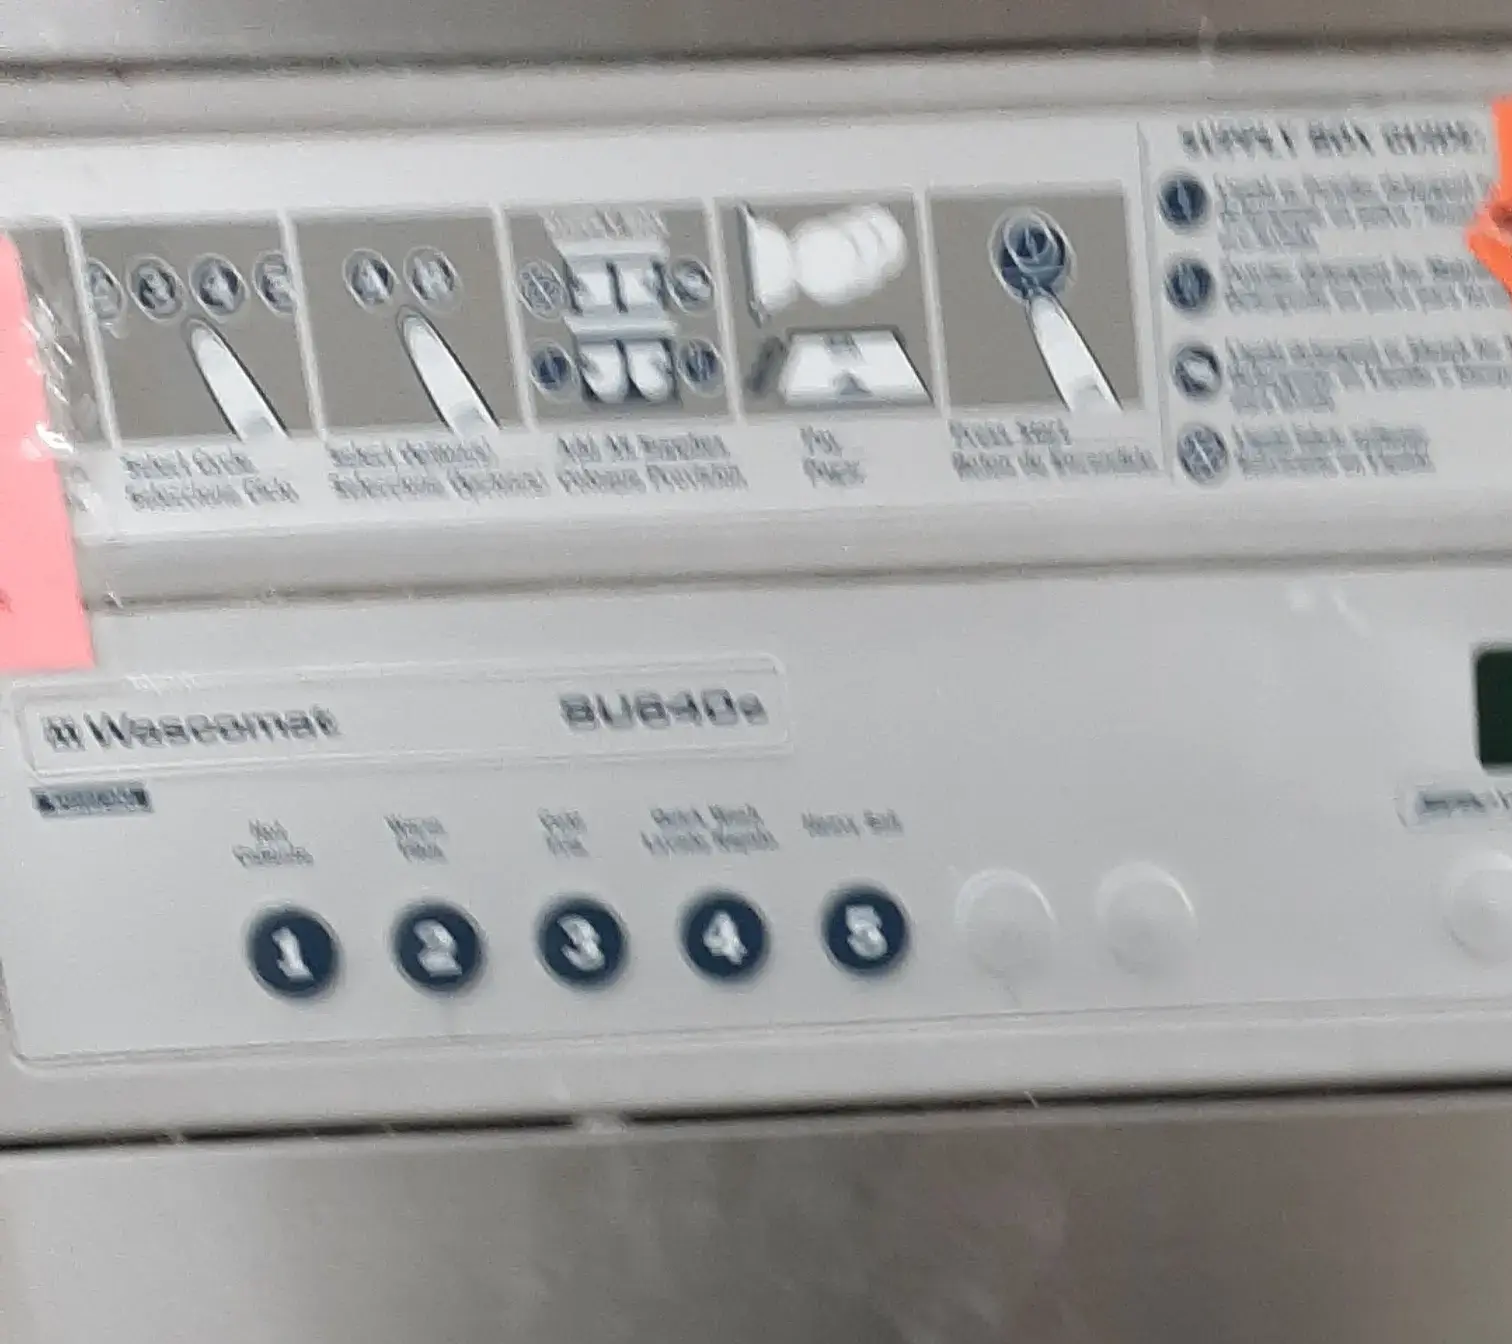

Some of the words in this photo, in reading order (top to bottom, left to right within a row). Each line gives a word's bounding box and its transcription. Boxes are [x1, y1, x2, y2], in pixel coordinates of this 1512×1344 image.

[83, 704, 341, 750] Wascomat
[270, 925, 315, 983] 1
[413, 917, 463, 979] 2
[556, 912, 605, 972] 3
[701, 909, 749, 967] 4
[844, 904, 889, 961] 5
